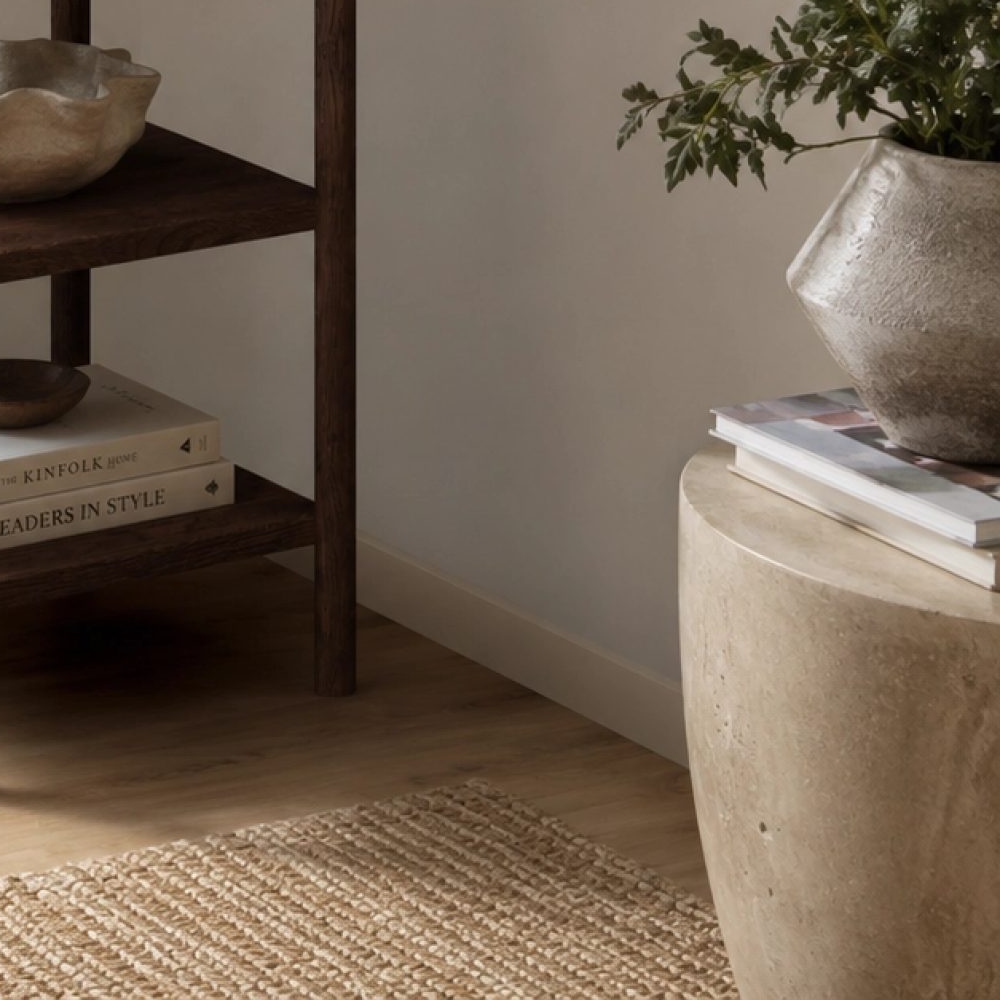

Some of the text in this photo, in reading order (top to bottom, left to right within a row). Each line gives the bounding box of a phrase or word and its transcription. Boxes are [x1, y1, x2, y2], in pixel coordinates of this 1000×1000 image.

[23, 456, 104, 485] KINFOLK
[79, 501, 100, 522] IN
[106, 488, 166, 516] STYLE
